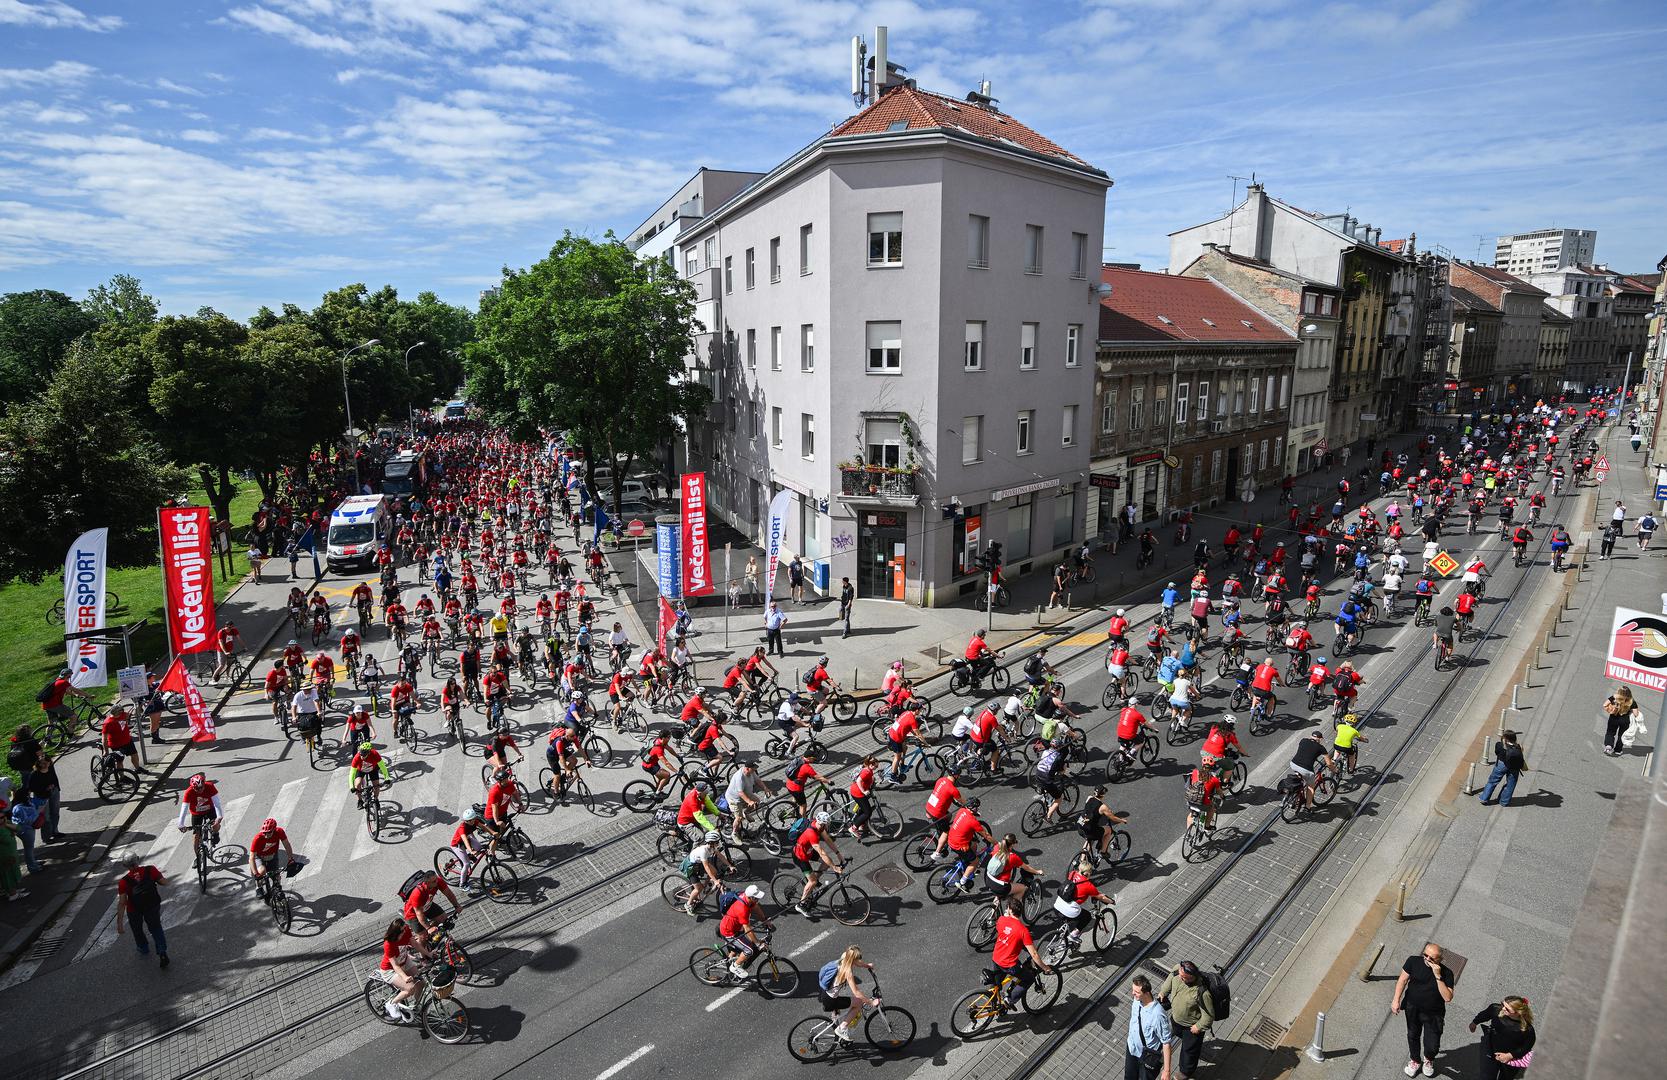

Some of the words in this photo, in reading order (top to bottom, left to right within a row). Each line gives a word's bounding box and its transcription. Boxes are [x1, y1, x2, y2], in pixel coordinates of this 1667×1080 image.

[172, 512, 199, 549] list
[687, 477, 702, 509] list
[688, 511, 706, 593] Večernji
[77, 549, 97, 656] INERSPORT
[174, 552, 205, 650] Večernji
